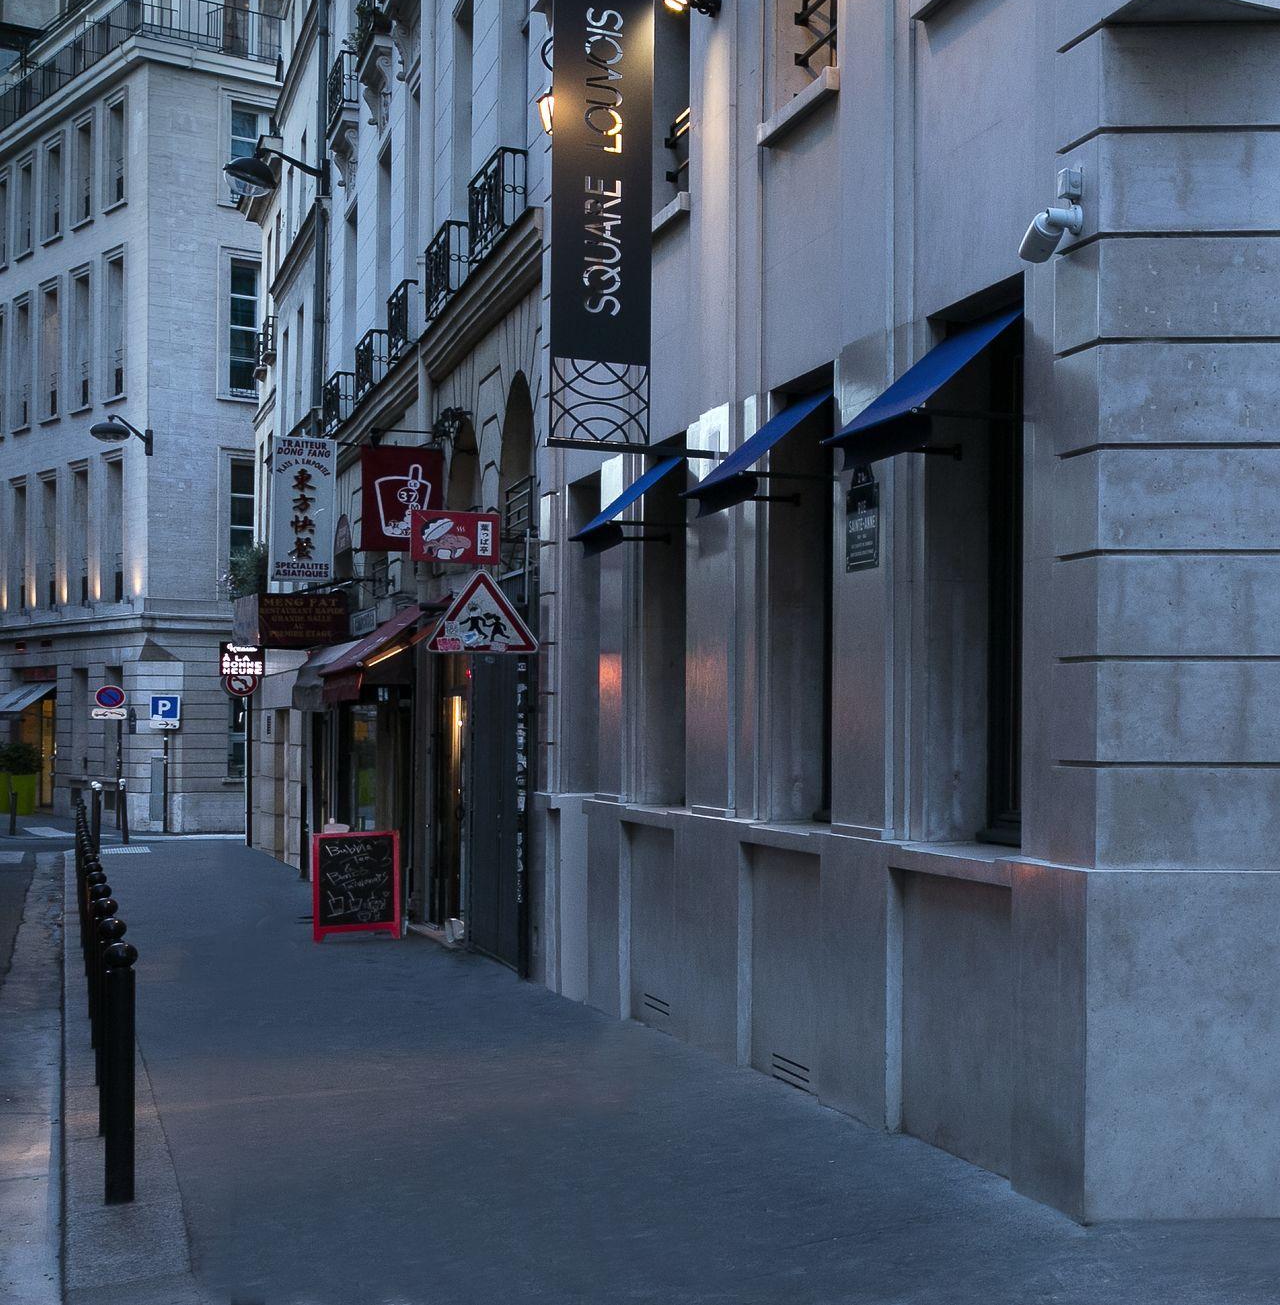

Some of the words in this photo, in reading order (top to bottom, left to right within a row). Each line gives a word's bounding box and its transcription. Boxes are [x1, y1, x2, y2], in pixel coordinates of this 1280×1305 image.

[584, 6, 624, 154] LOUVOIS
[582, 175, 622, 316] SQUARE
[282, 439, 327, 450] TRAITEUR
[277, 447, 304, 456] DONG
[308, 449, 331, 458] FANG
[399, 491, 417, 502] 37
[275, 561, 330, 571] SPECIALITES
[275, 569, 329, 578] ASIATIQUES
[222, 667, 262, 675] HEURE
[158, 700, 171, 714] P
